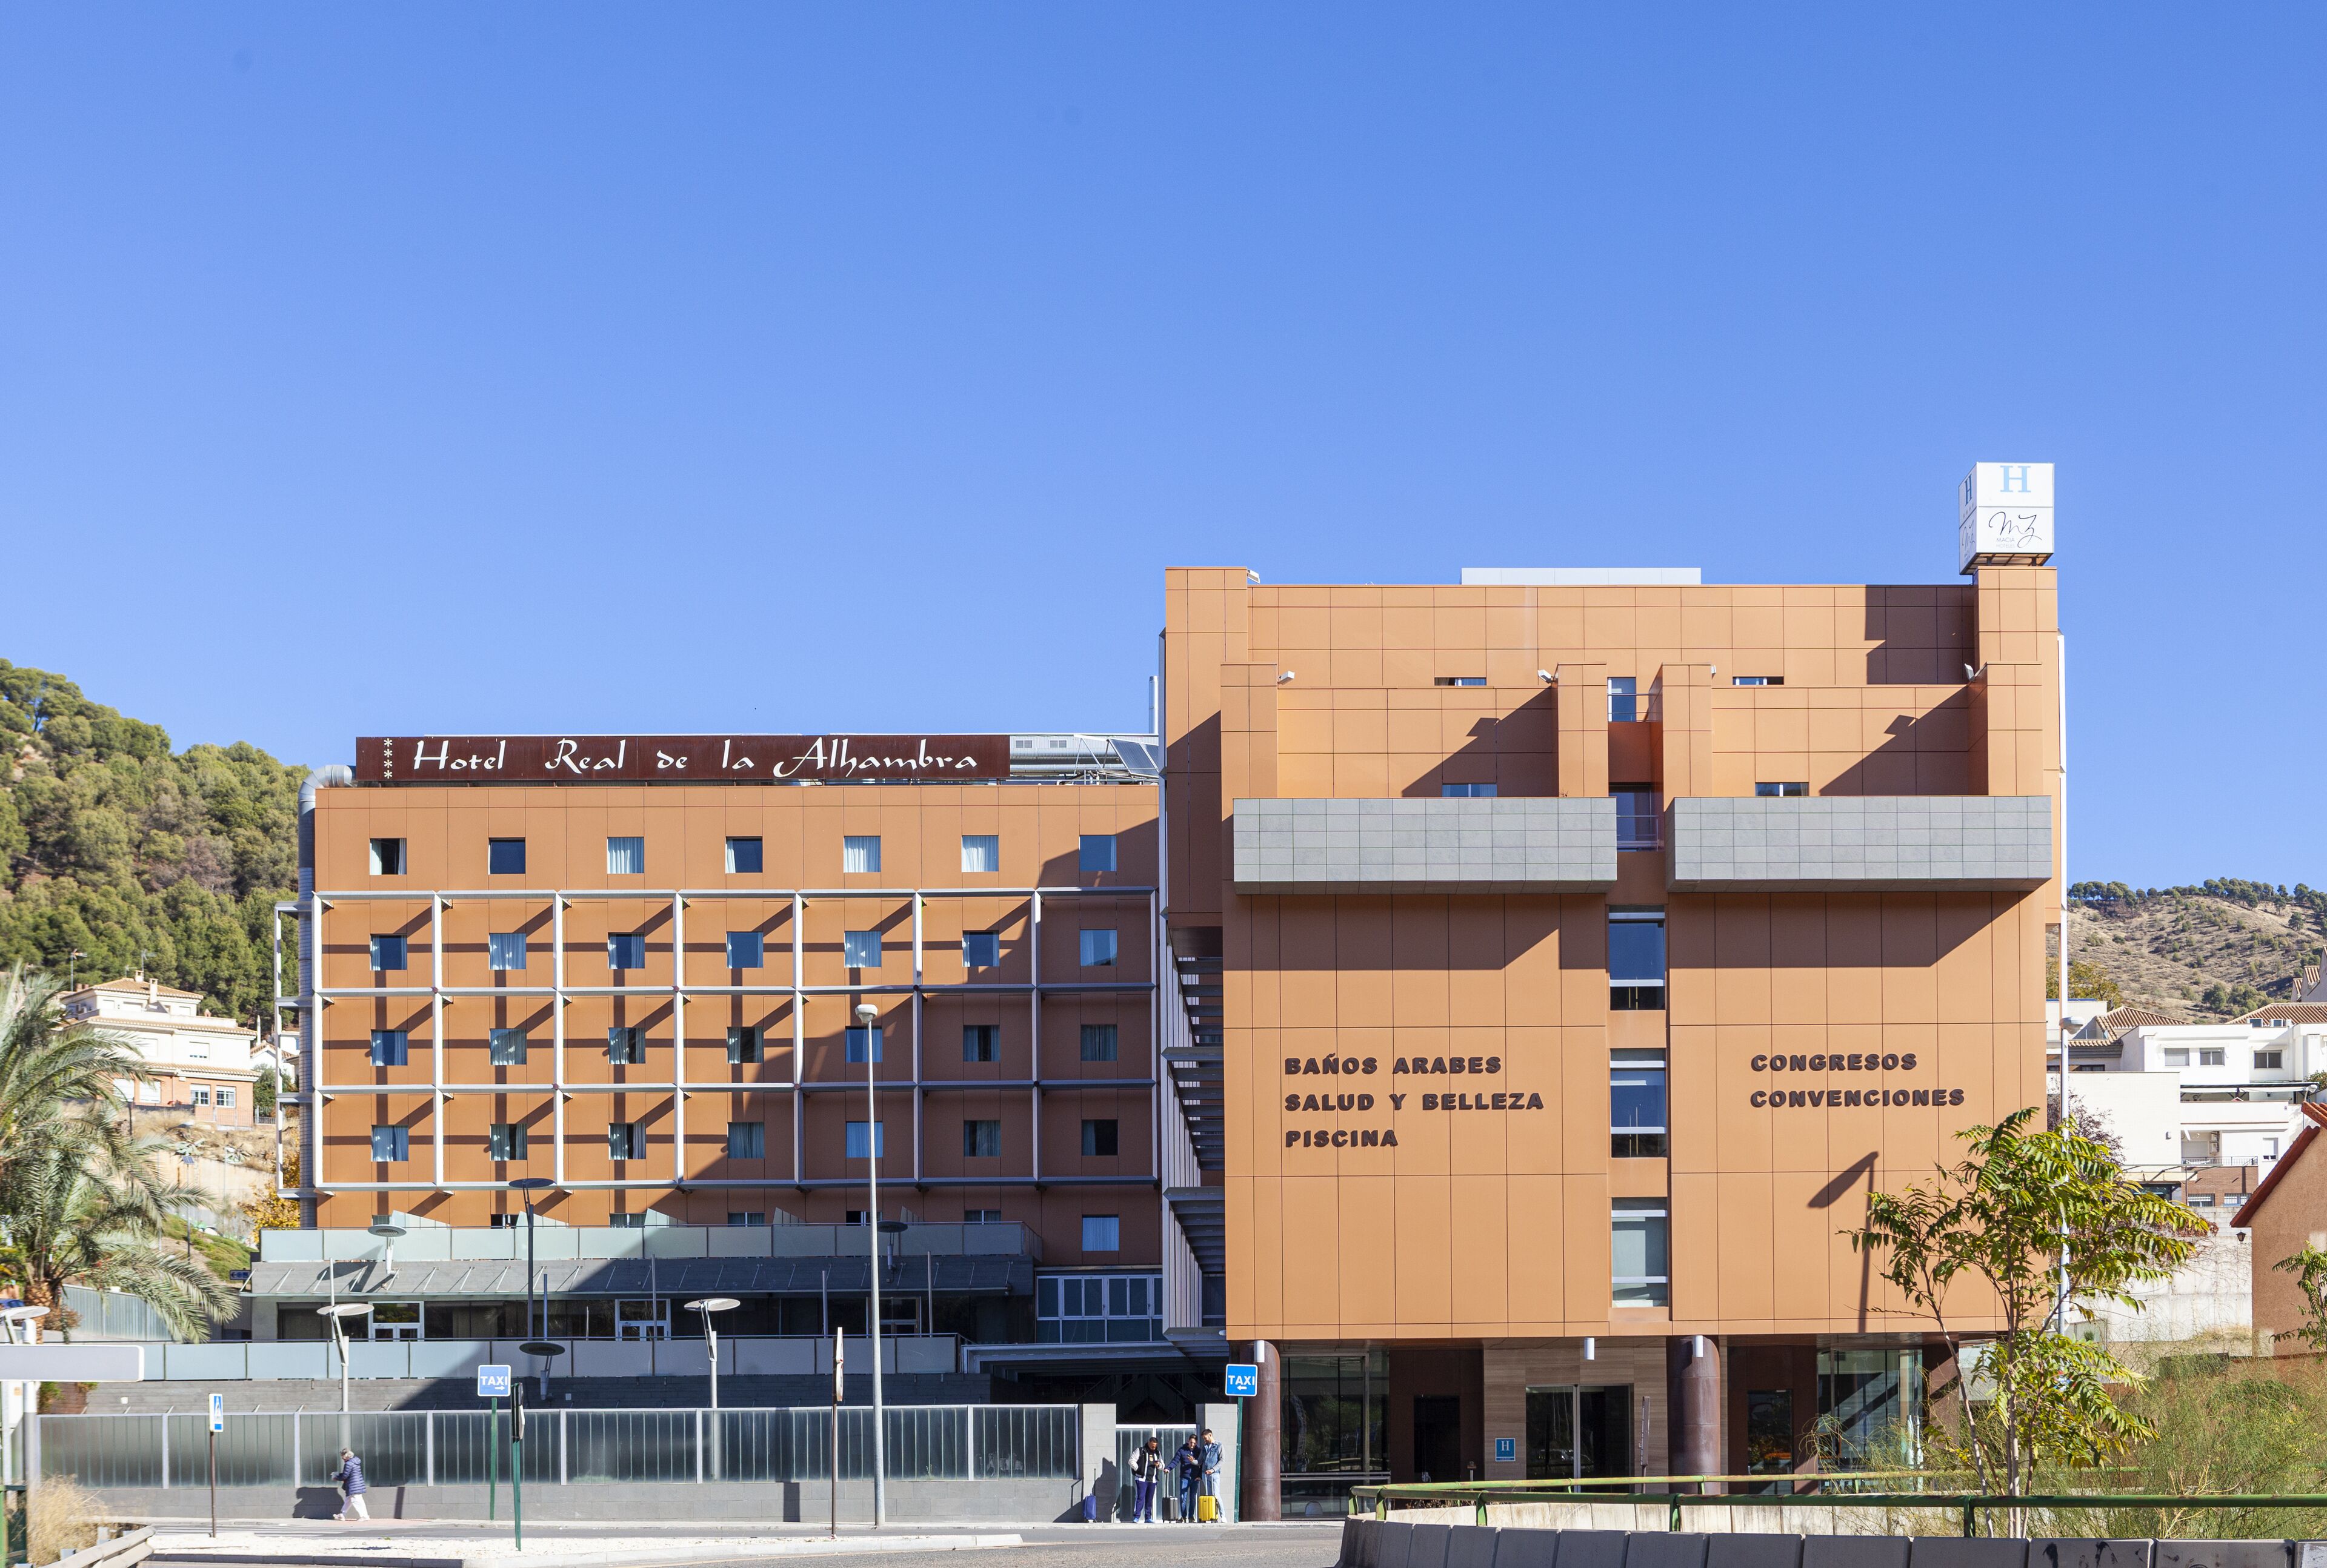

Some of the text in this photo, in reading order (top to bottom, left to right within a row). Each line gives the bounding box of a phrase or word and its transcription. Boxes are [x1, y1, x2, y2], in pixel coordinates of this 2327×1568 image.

[2000, 465, 2031, 493] H
[413, 736, 977, 777] Hotel Real de la Alhambra
[1285, 1053, 1502, 1075] BAÑOS ARABES
[1751, 1053, 1917, 1071] CONGRESOS
[1284, 1092, 1544, 1111] SALUD Y BELLEZA
[1750, 1089, 1965, 1108] CONVENCIONES
[1285, 1129, 1399, 1148] PISCINA
[480, 1376, 508, 1386] TAXI
[1228, 1375, 1255, 1386] TAXI
[1501, 1440, 1510, 1451] H
